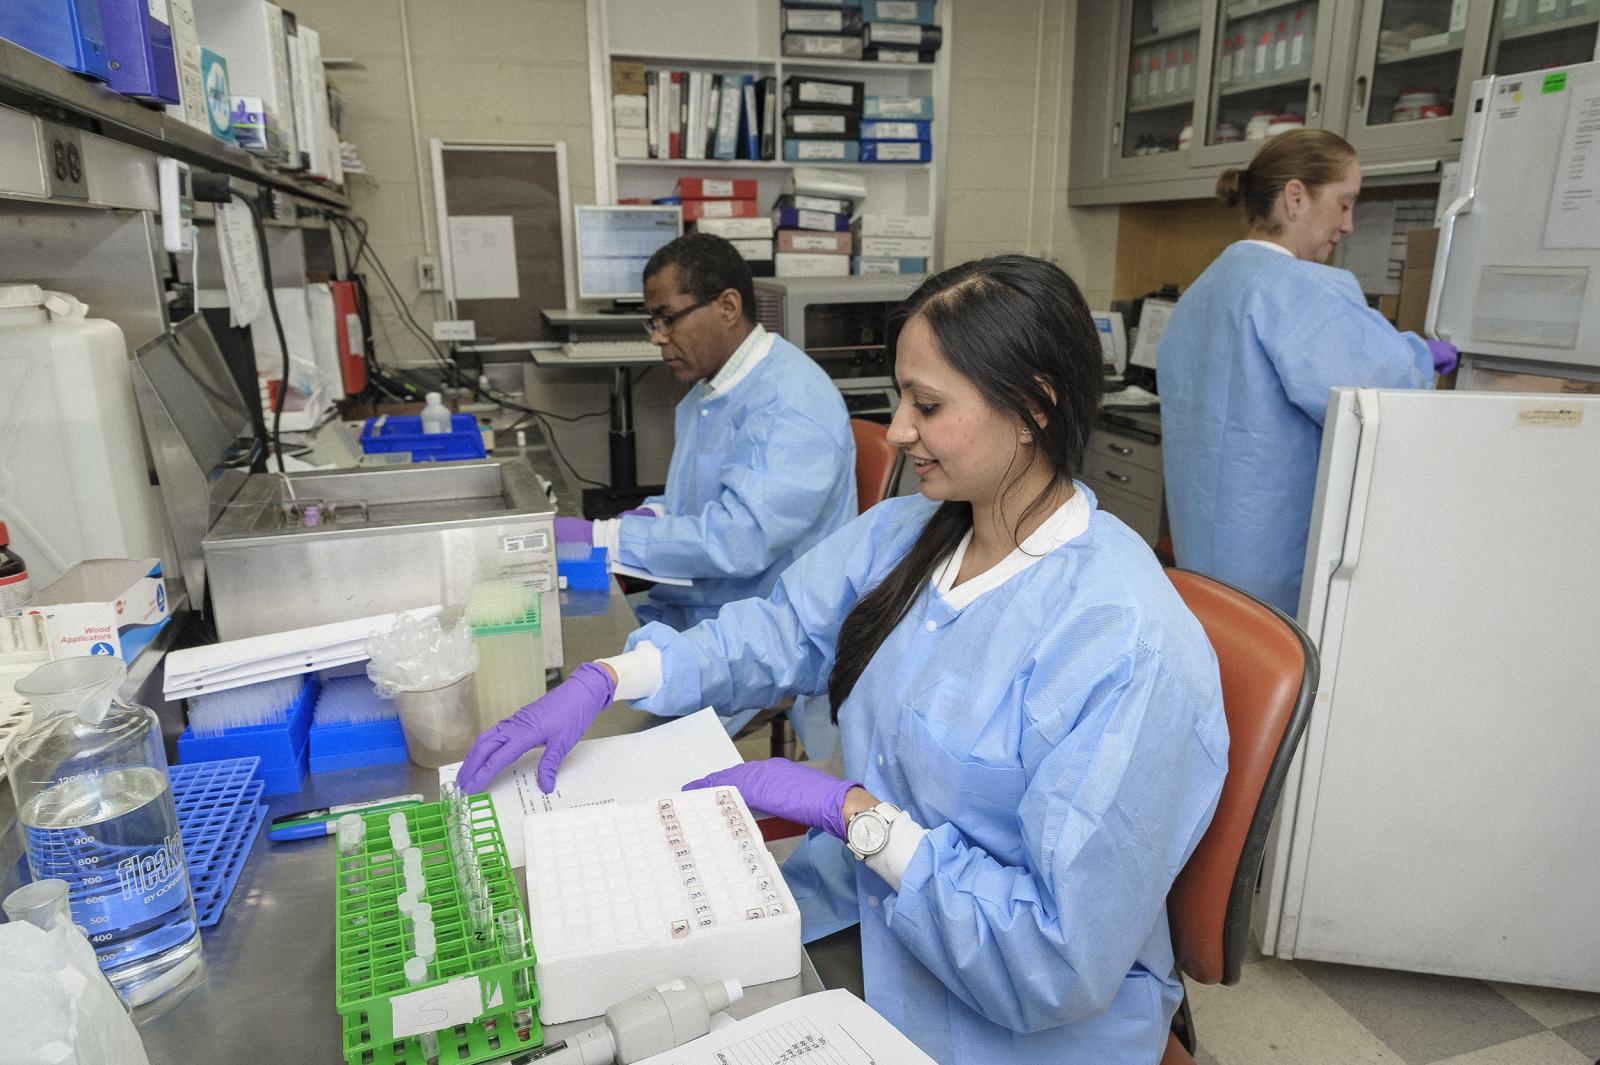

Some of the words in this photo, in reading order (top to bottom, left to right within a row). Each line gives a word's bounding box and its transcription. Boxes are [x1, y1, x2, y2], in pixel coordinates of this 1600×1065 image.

[84, 626, 111, 634] Wood
[60, 634, 112, 643] Applicators
[73, 835, 95, 846] 900
[78, 856, 99, 866] 800
[82, 875, 102, 886] 700
[85, 895, 105, 905] 600
[90, 915, 110, 925] 500
[93, 933, 113, 942] 400
